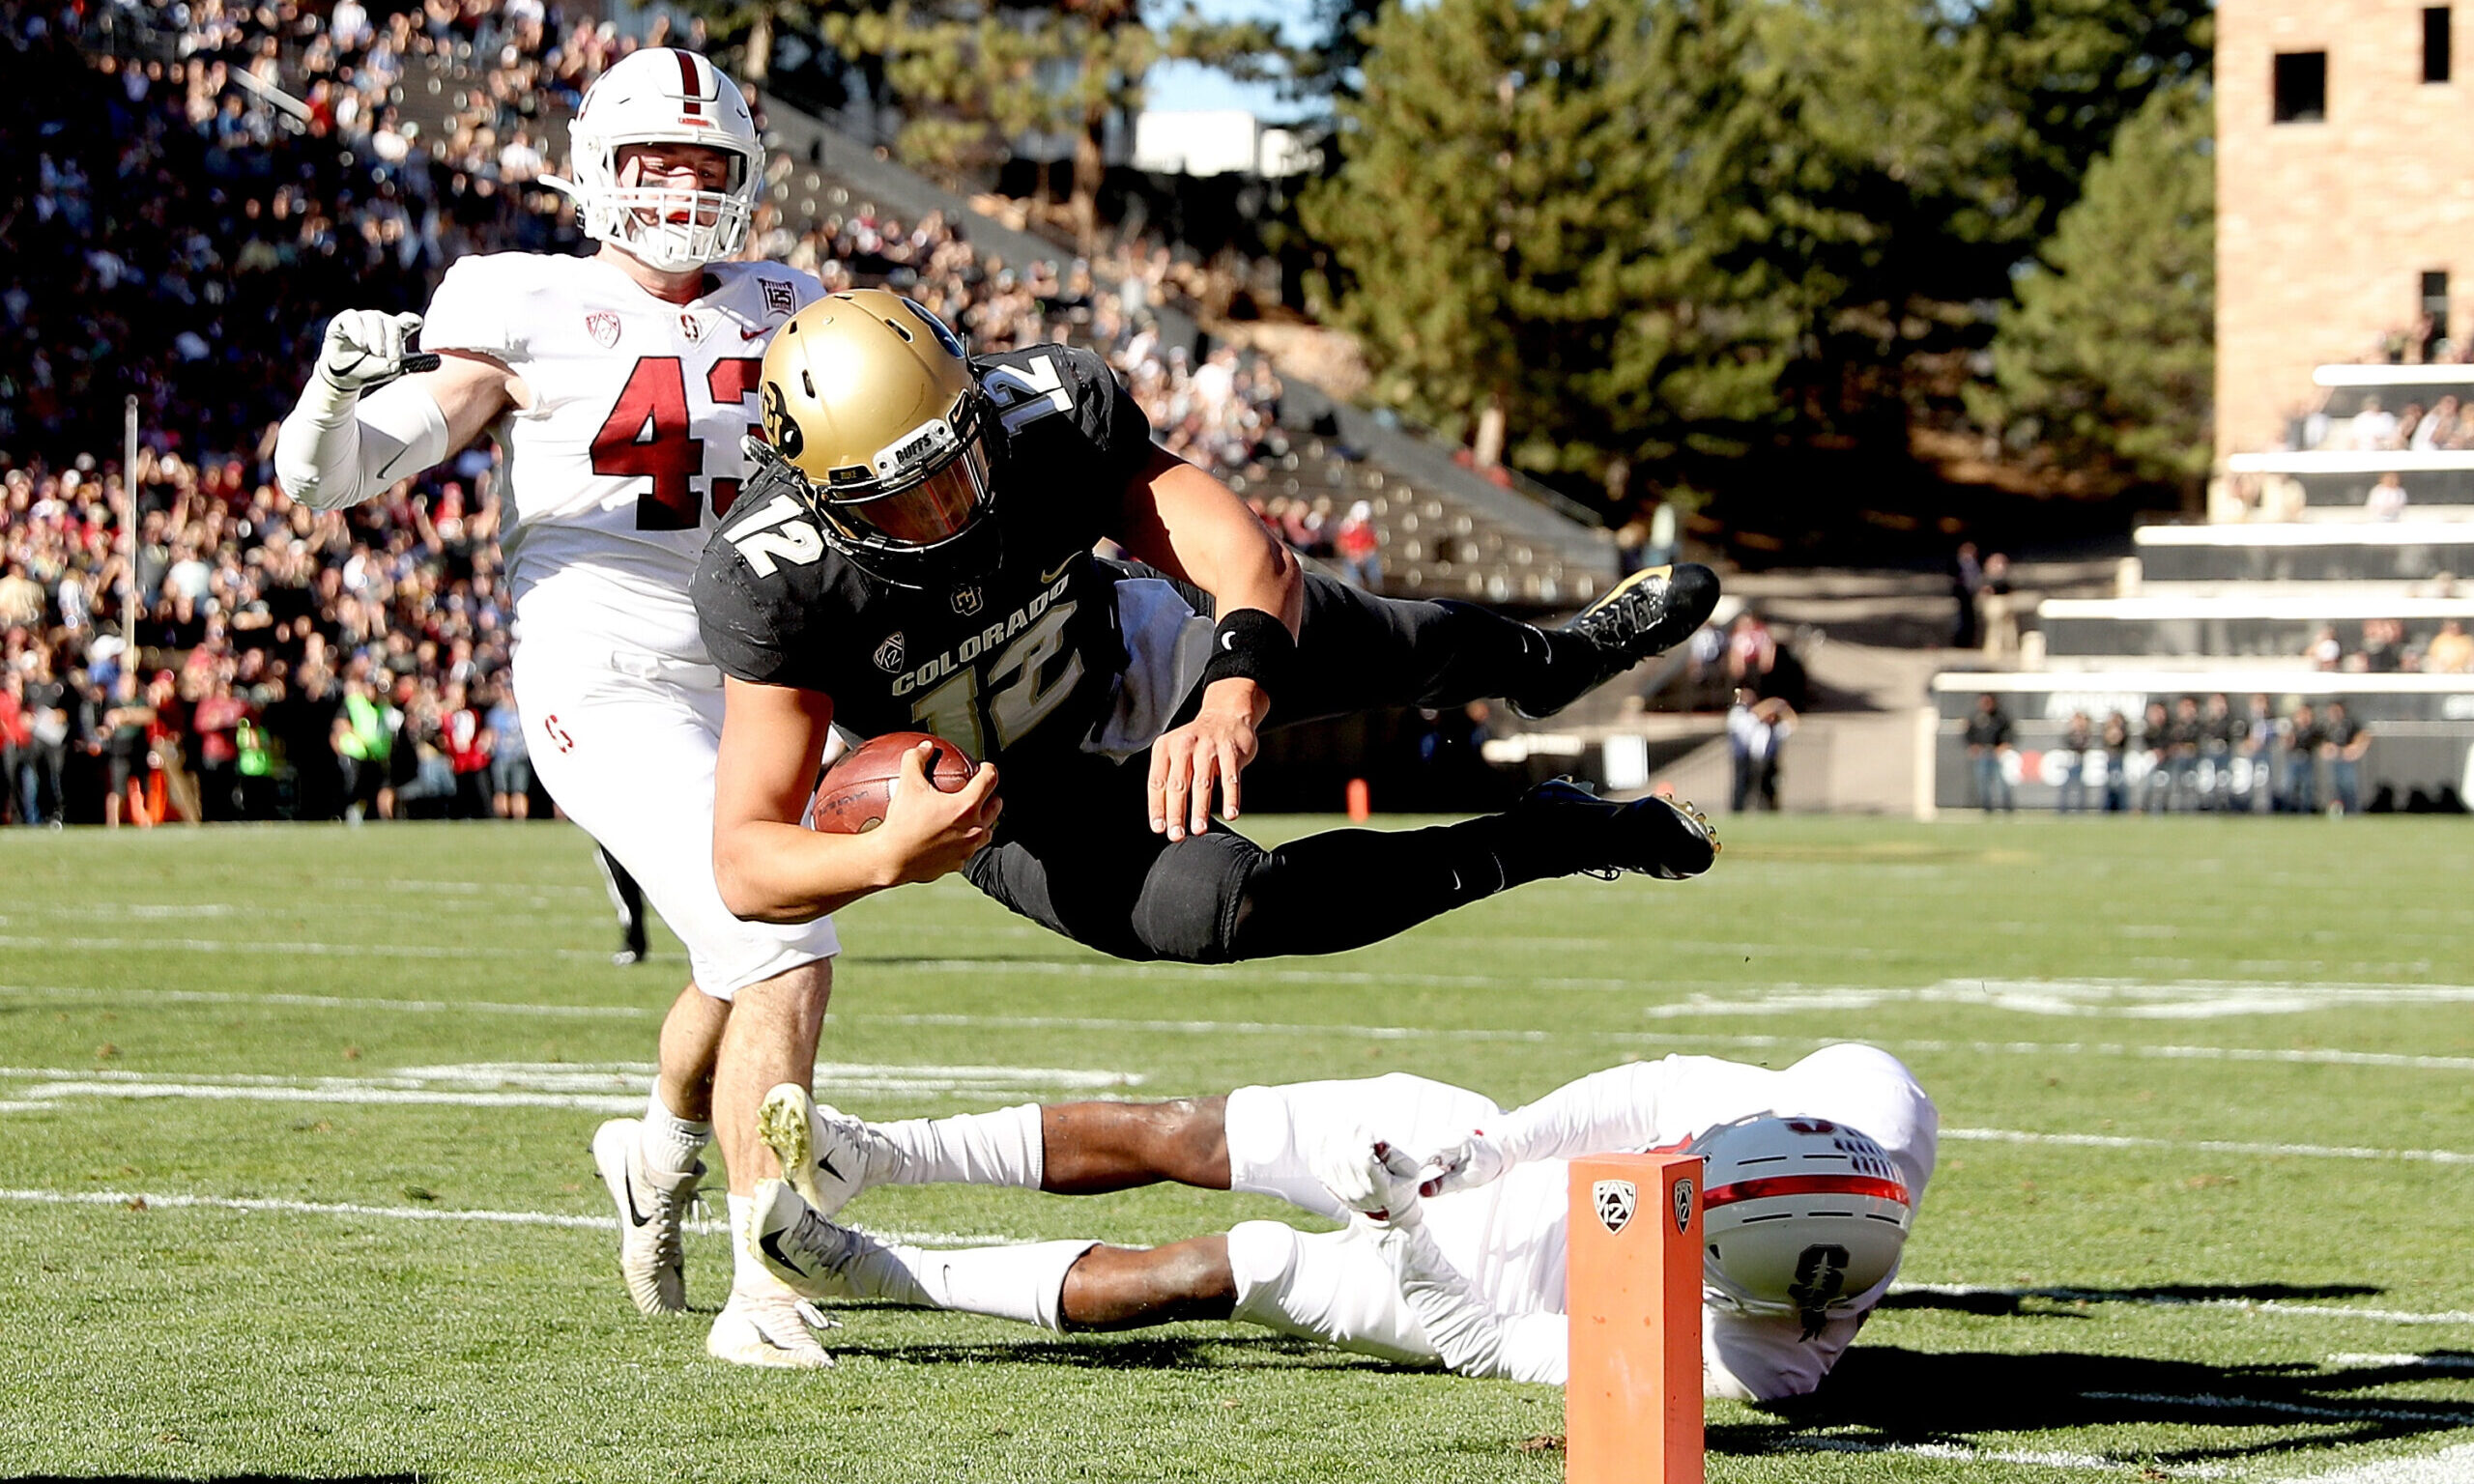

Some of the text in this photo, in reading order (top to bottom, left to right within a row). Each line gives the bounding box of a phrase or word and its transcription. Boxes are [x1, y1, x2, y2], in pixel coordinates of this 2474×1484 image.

[980, 354, 1075, 438] 12
[895, 433, 933, 465] BUFFS
[722, 494, 824, 580] 12
[892, 573, 1070, 697] COLORADO
[884, 649, 901, 669] 12
[911, 600, 1085, 761] 12
[1595, 1182, 1633, 1214] PAC
[1603, 1203, 1625, 1224] 12
[1679, 1203, 1689, 1222] 12
